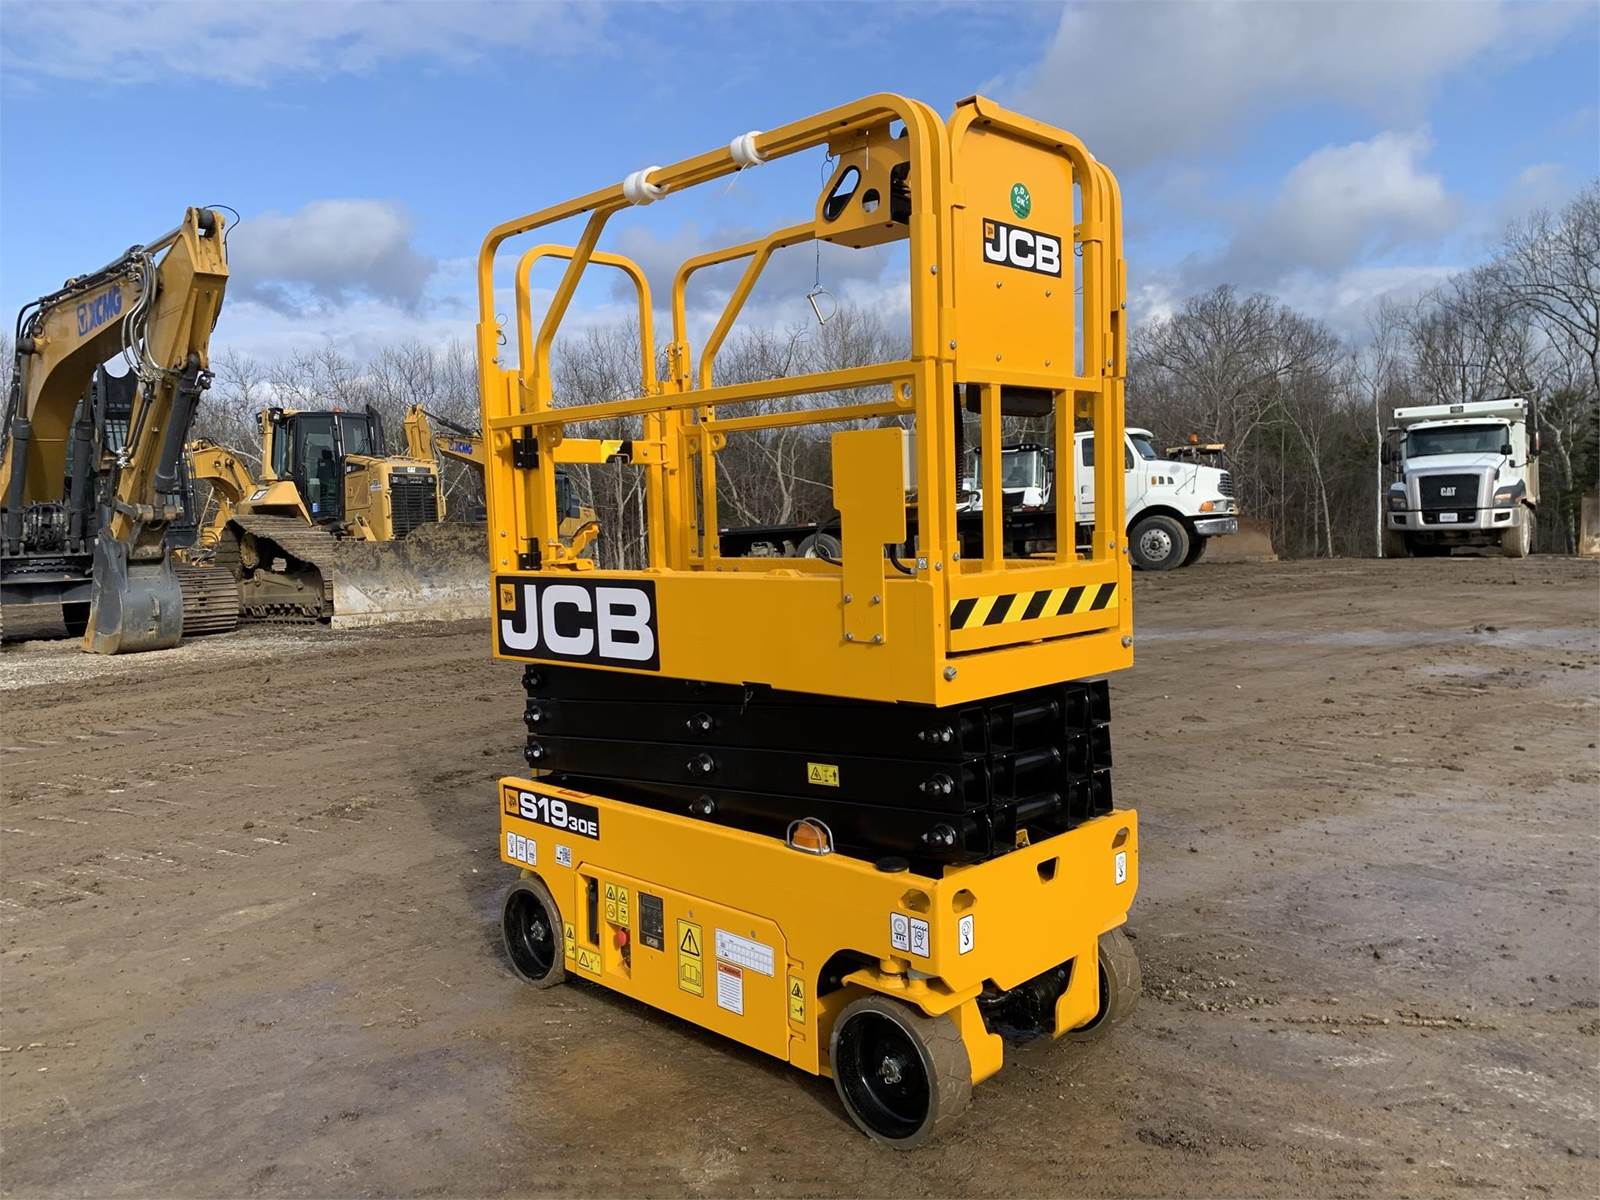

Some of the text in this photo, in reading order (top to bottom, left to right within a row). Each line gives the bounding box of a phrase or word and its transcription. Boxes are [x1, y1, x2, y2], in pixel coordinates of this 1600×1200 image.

[985, 225, 1060, 274] JCB
[89, 286, 122, 332] XCMG
[1440, 487, 1457, 497] CAT
[501, 584, 655, 661] JCB
